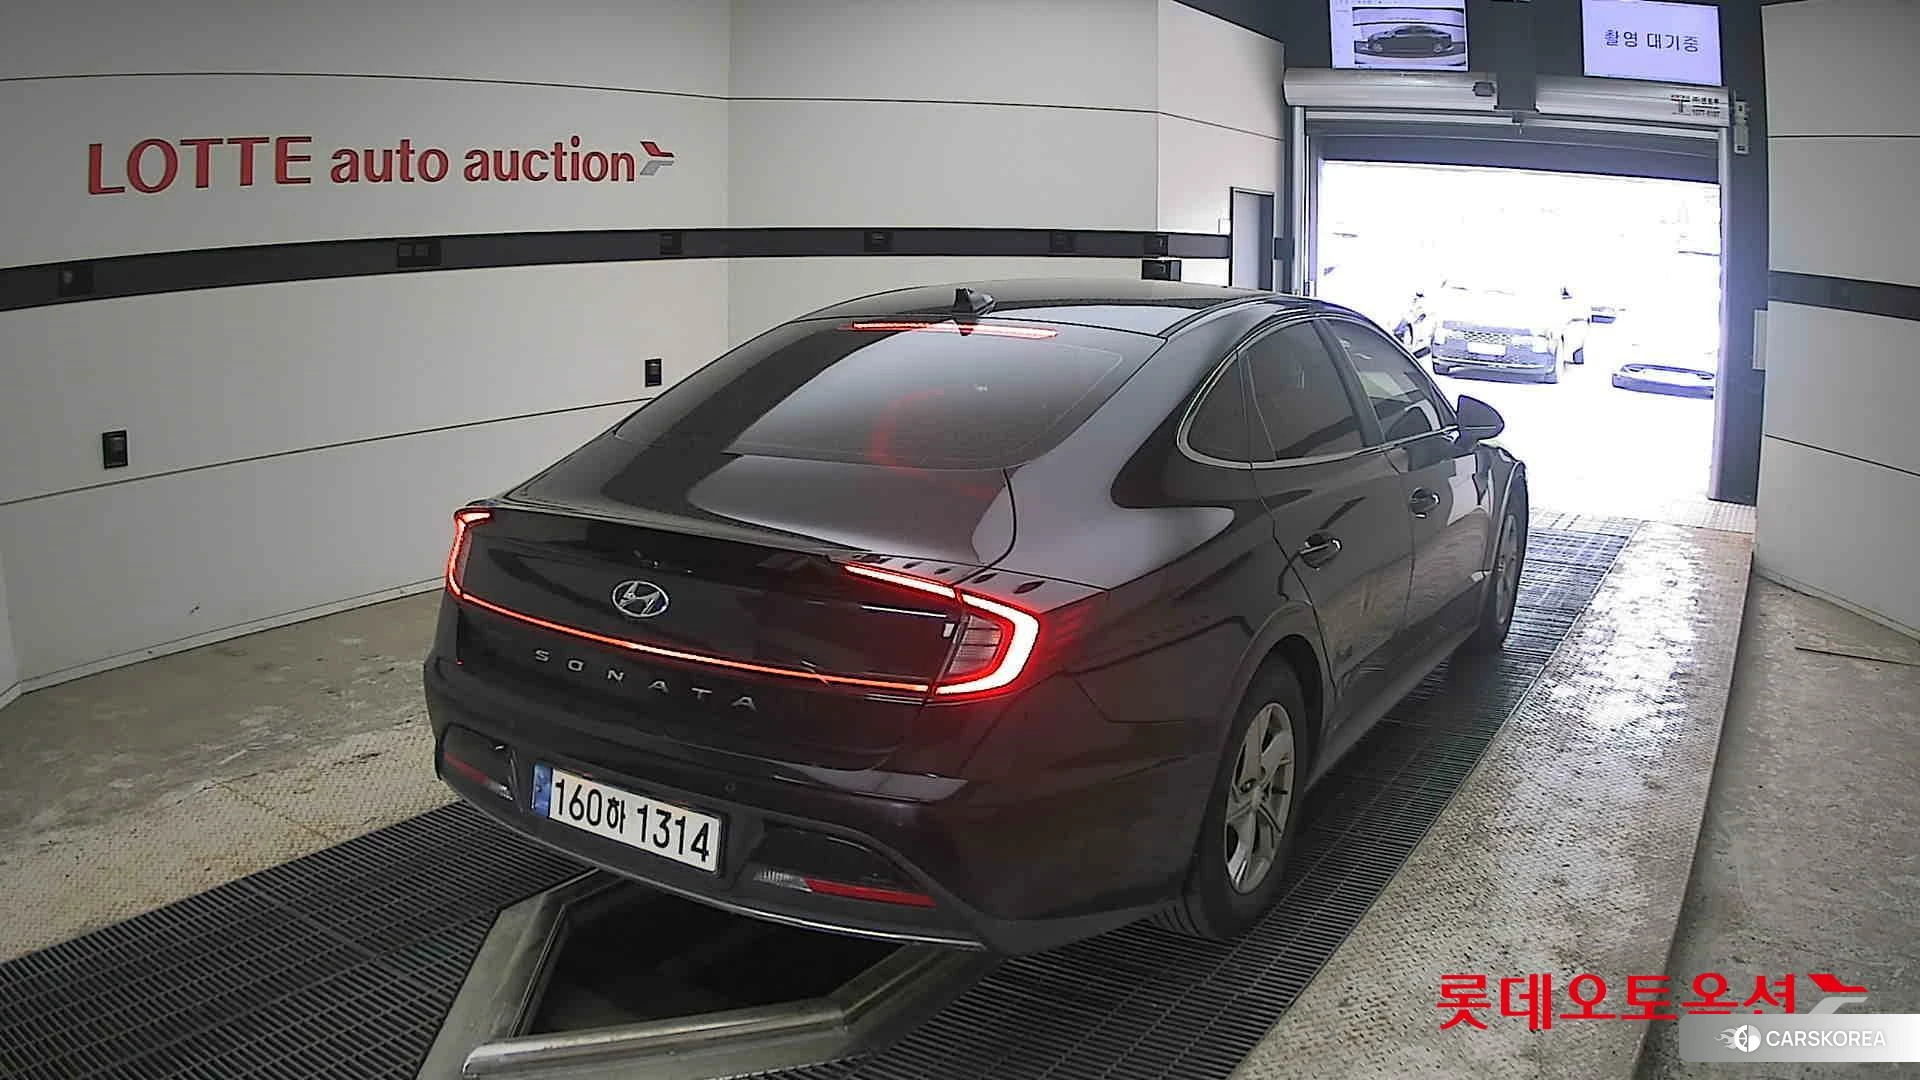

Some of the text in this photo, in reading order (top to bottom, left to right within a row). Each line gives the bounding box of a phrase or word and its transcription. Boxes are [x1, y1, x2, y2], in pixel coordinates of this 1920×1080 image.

[1604, 29, 1699, 53] 촬영 대기중
[88, 135, 636, 195] LOTTE auto auction
[535, 649, 758, 712] SONATA
[554, 777, 711, 863] 160하 1314
